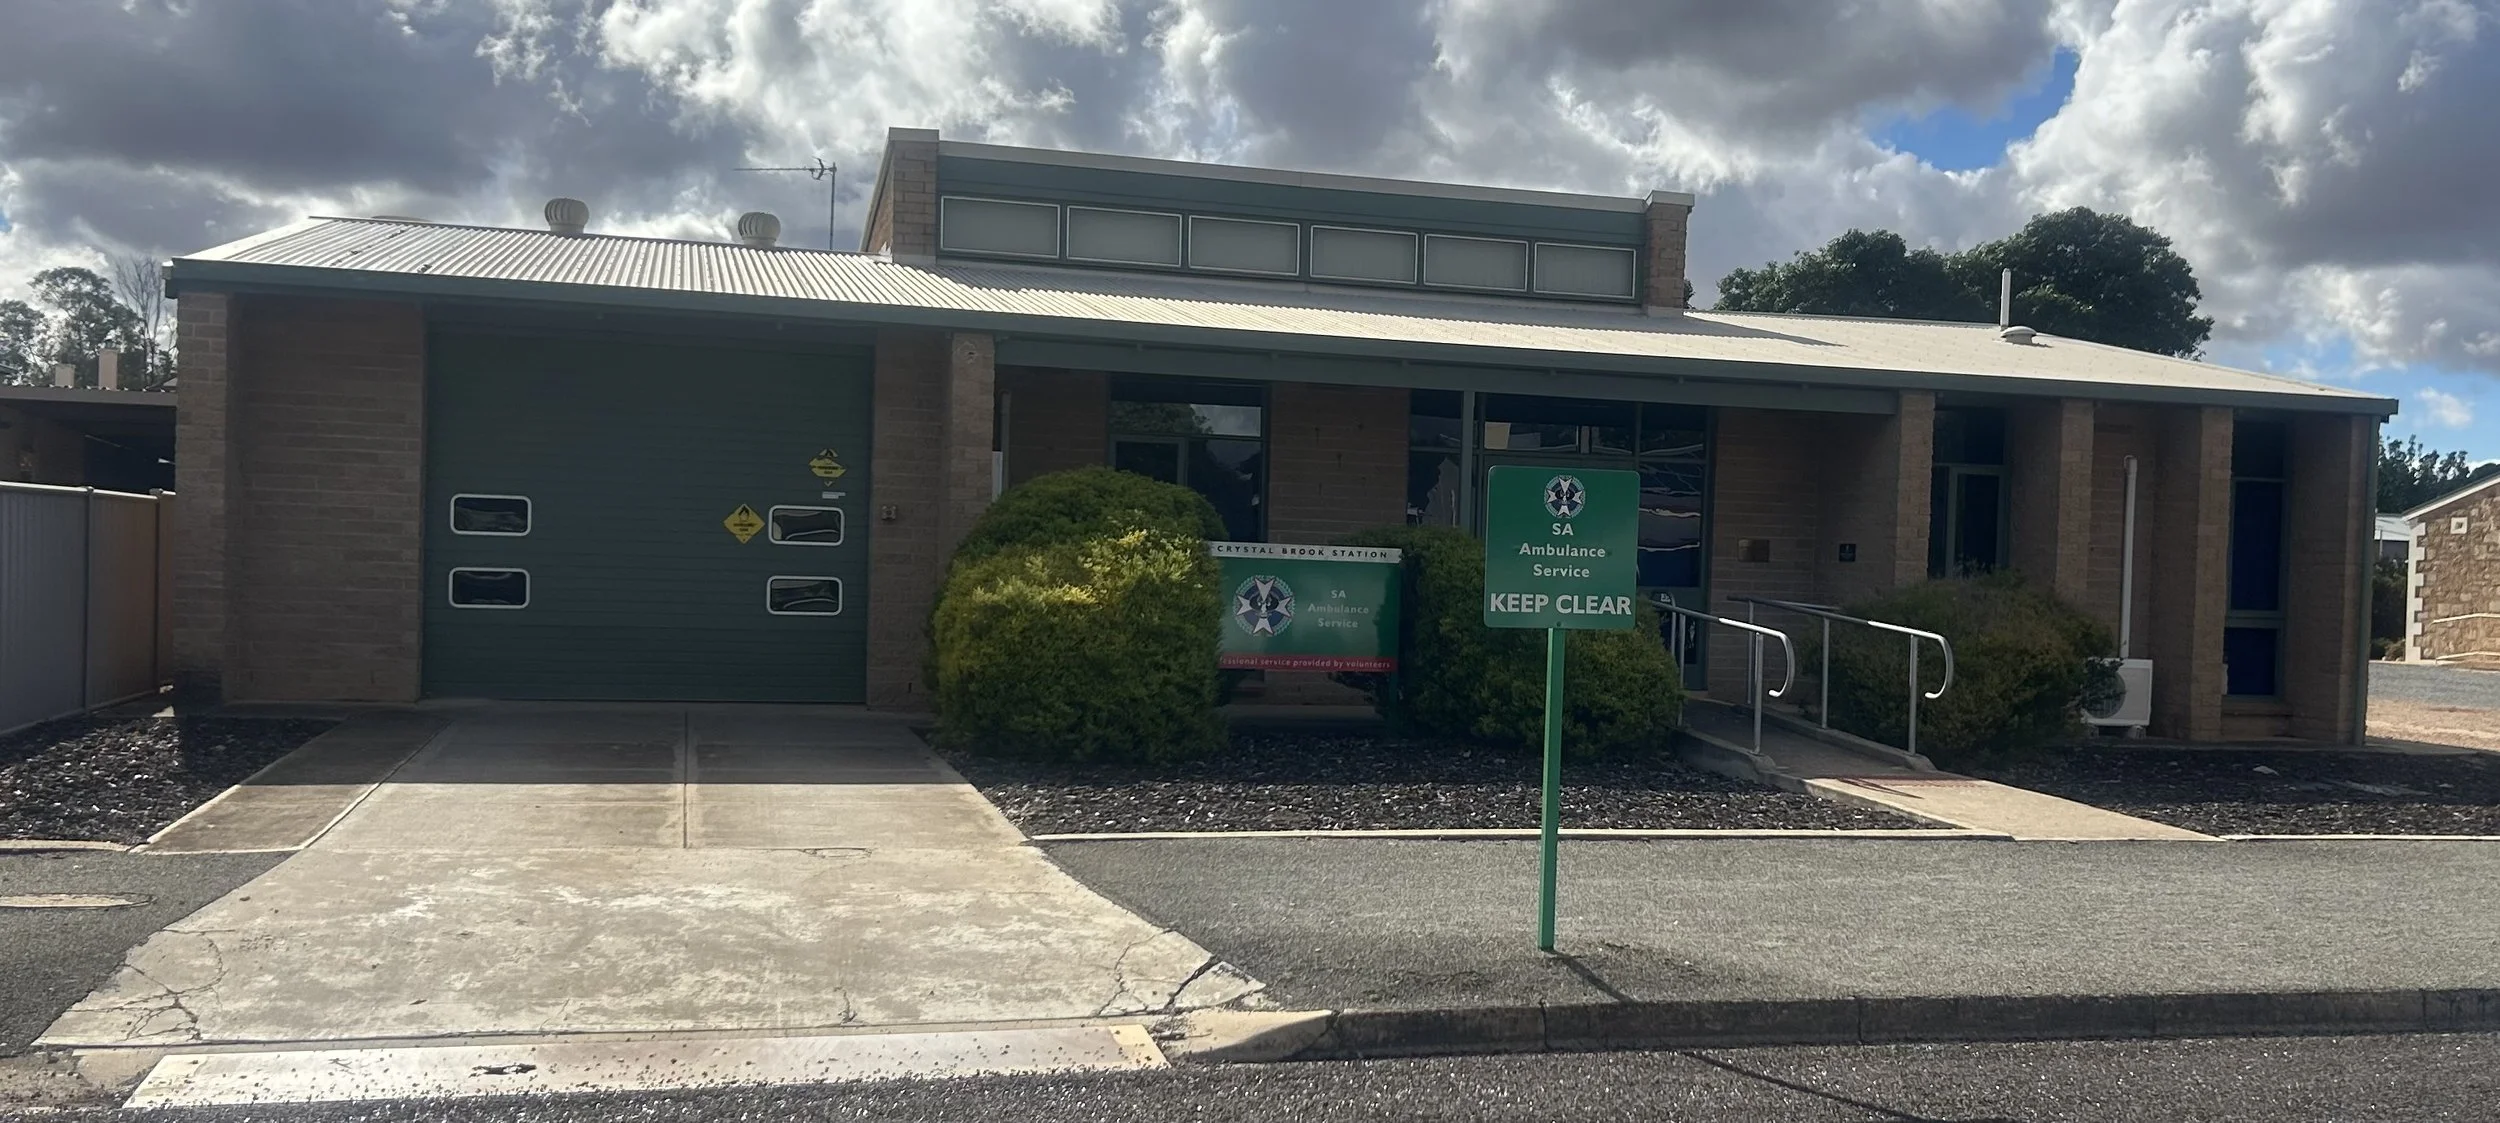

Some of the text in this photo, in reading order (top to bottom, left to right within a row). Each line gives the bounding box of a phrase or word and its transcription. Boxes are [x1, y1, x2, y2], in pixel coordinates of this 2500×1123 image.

[1552, 523, 1574, 536] SA
[1217, 545, 1387, 558] CRYSTAL BROOK STATION
[1519, 542, 1606, 558] Ambulance
[1533, 563, 1590, 577] Service
[1331, 589, 1346, 599] SA
[1307, 603, 1369, 614] Ambulance
[1490, 593, 1632, 615] KEEP CLEAR
[1318, 617, 1359, 628] Service
[1293, 659, 1331, 668] provided
[1333, 660, 1344, 668] by
[1346, 660, 1391, 669] volunteers
